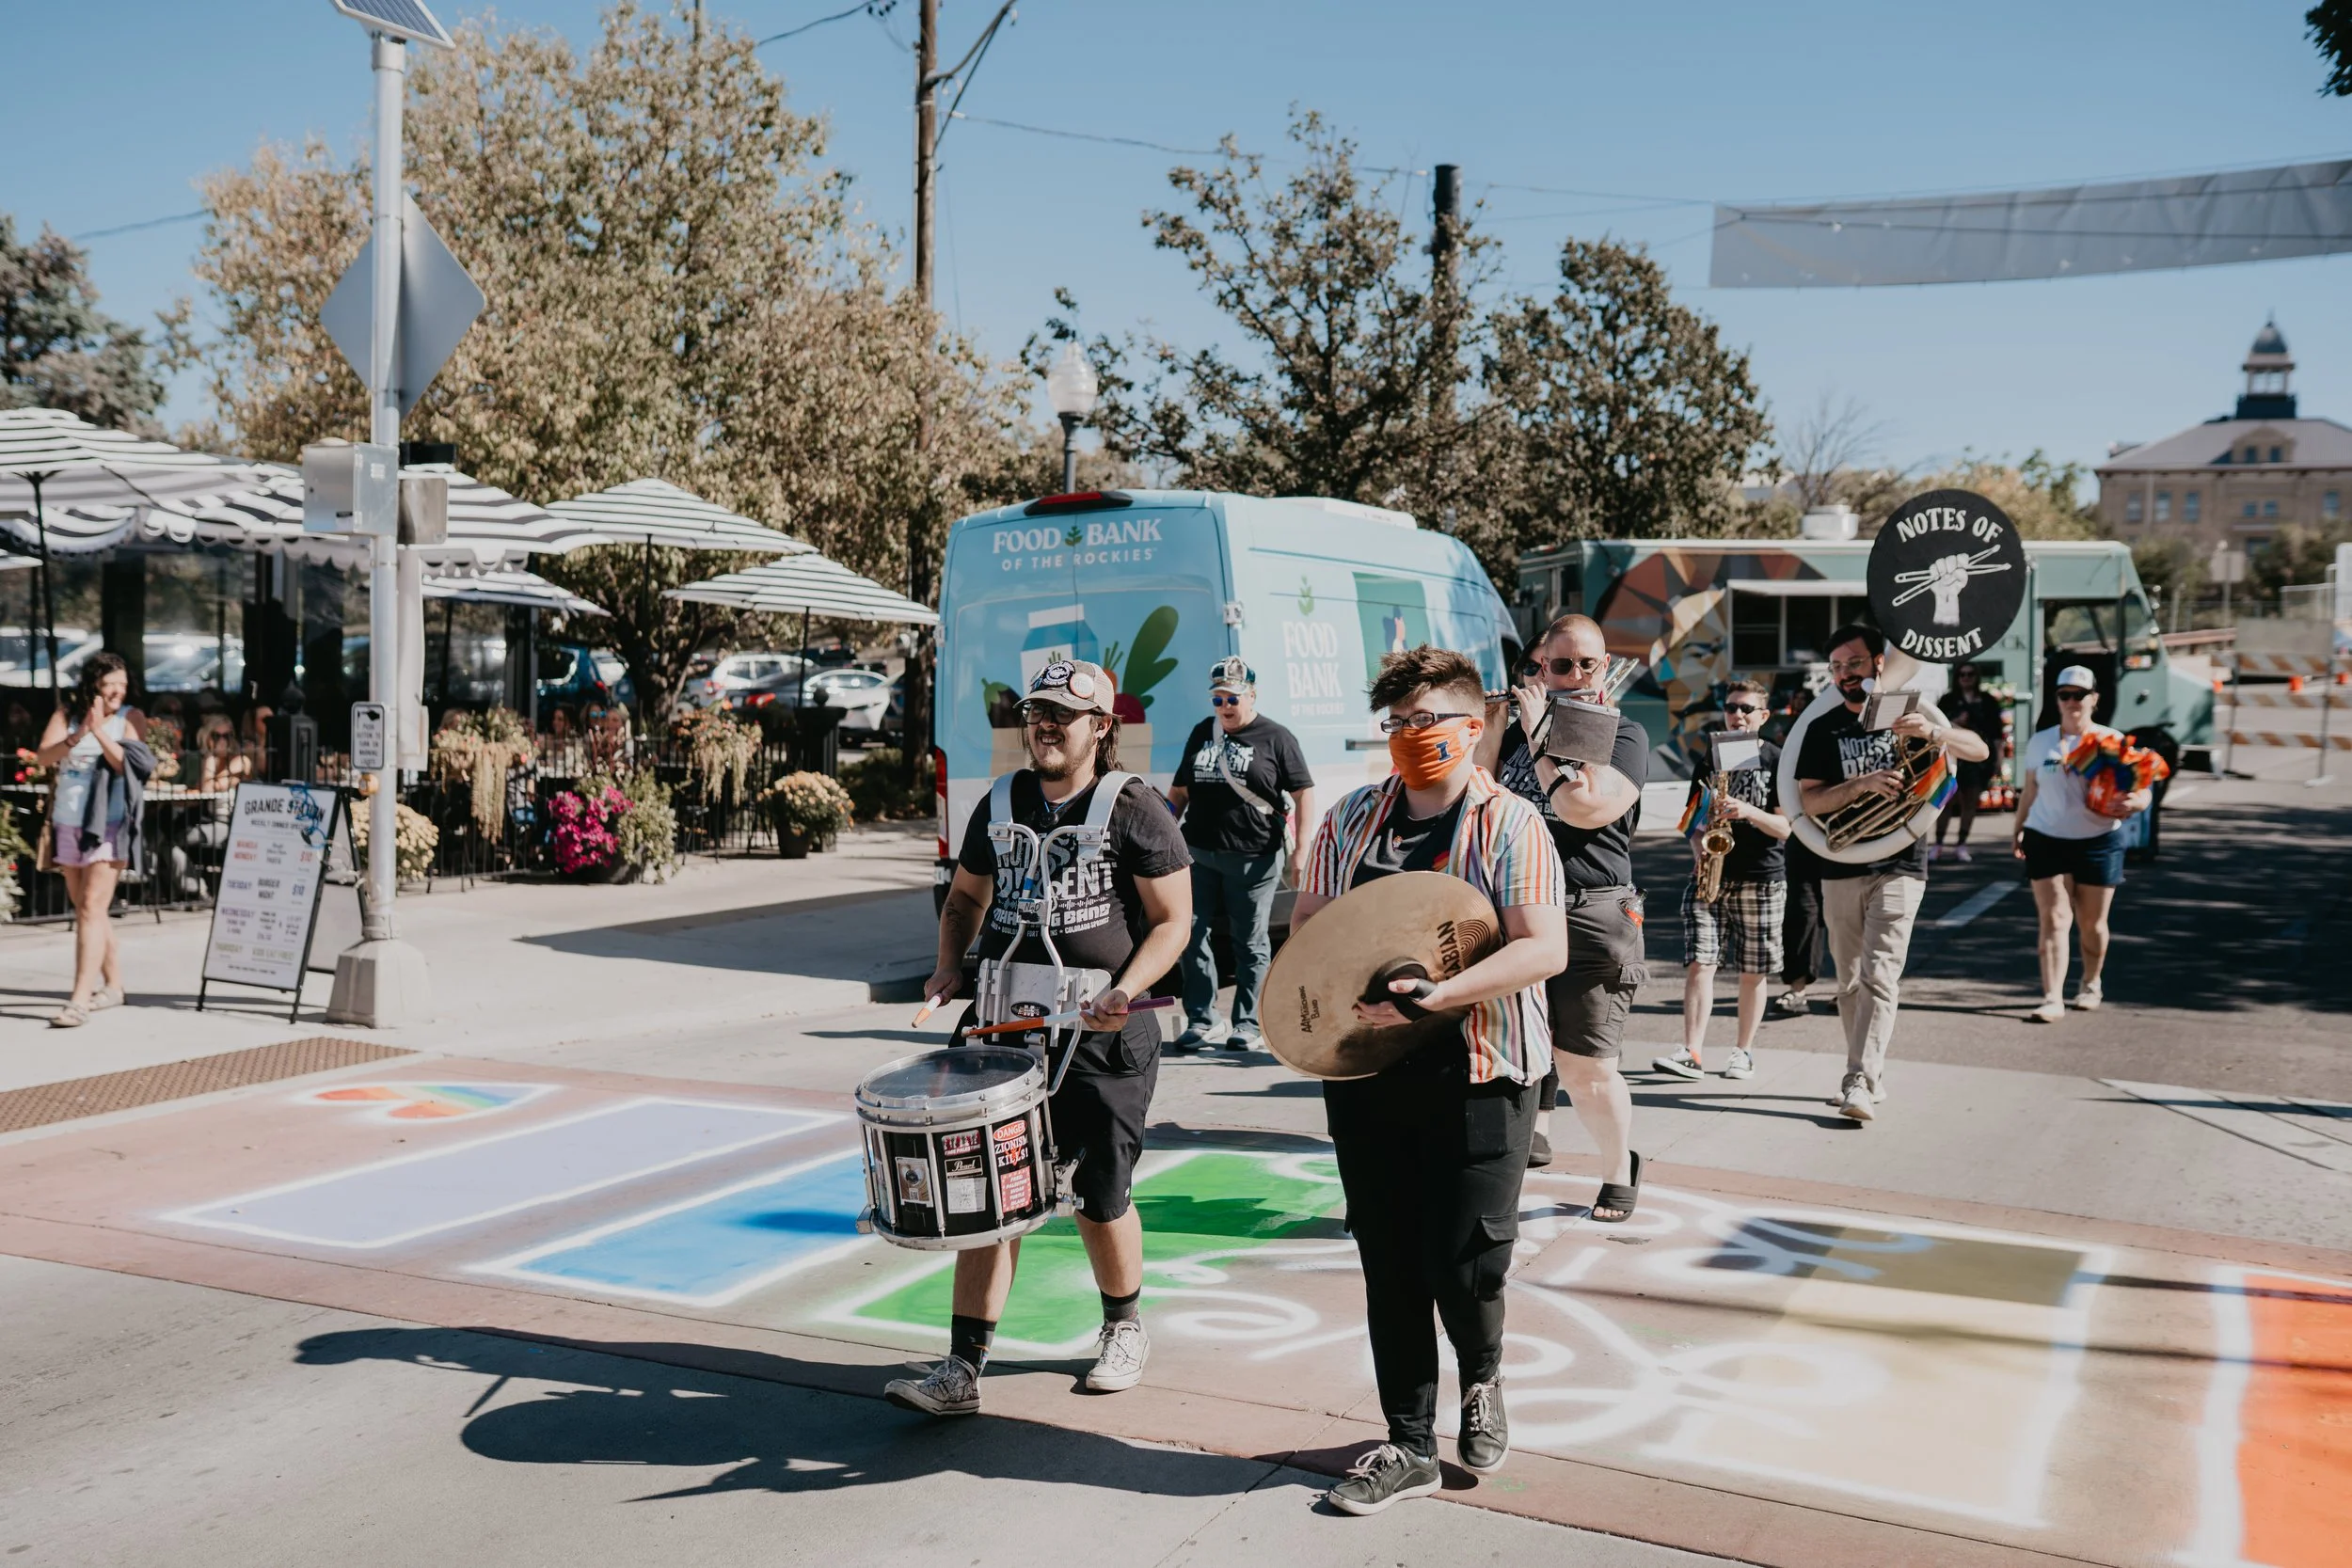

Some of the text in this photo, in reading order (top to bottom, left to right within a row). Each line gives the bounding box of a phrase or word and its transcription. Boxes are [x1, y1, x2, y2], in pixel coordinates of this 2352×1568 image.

[993, 518, 1162, 554] FOOD BANK
[1897, 507, 2004, 543] NOTES OF
[1002, 548, 1153, 571] OF THE ROCKIES
[1282, 621, 1338, 657] FOOD
[1900, 626, 1983, 657] DISSENT
[1286, 661, 1343, 698] BANK
[245, 798, 285, 816] GRANDE
[1064, 903, 1110, 926] BAND
[997, 1123, 1025, 1139] DANGER
[995, 1134, 1027, 1155] ZIONISM
[952, 1160, 976, 1172] Pearl
[998, 1147, 1028, 1167] KILLS!
